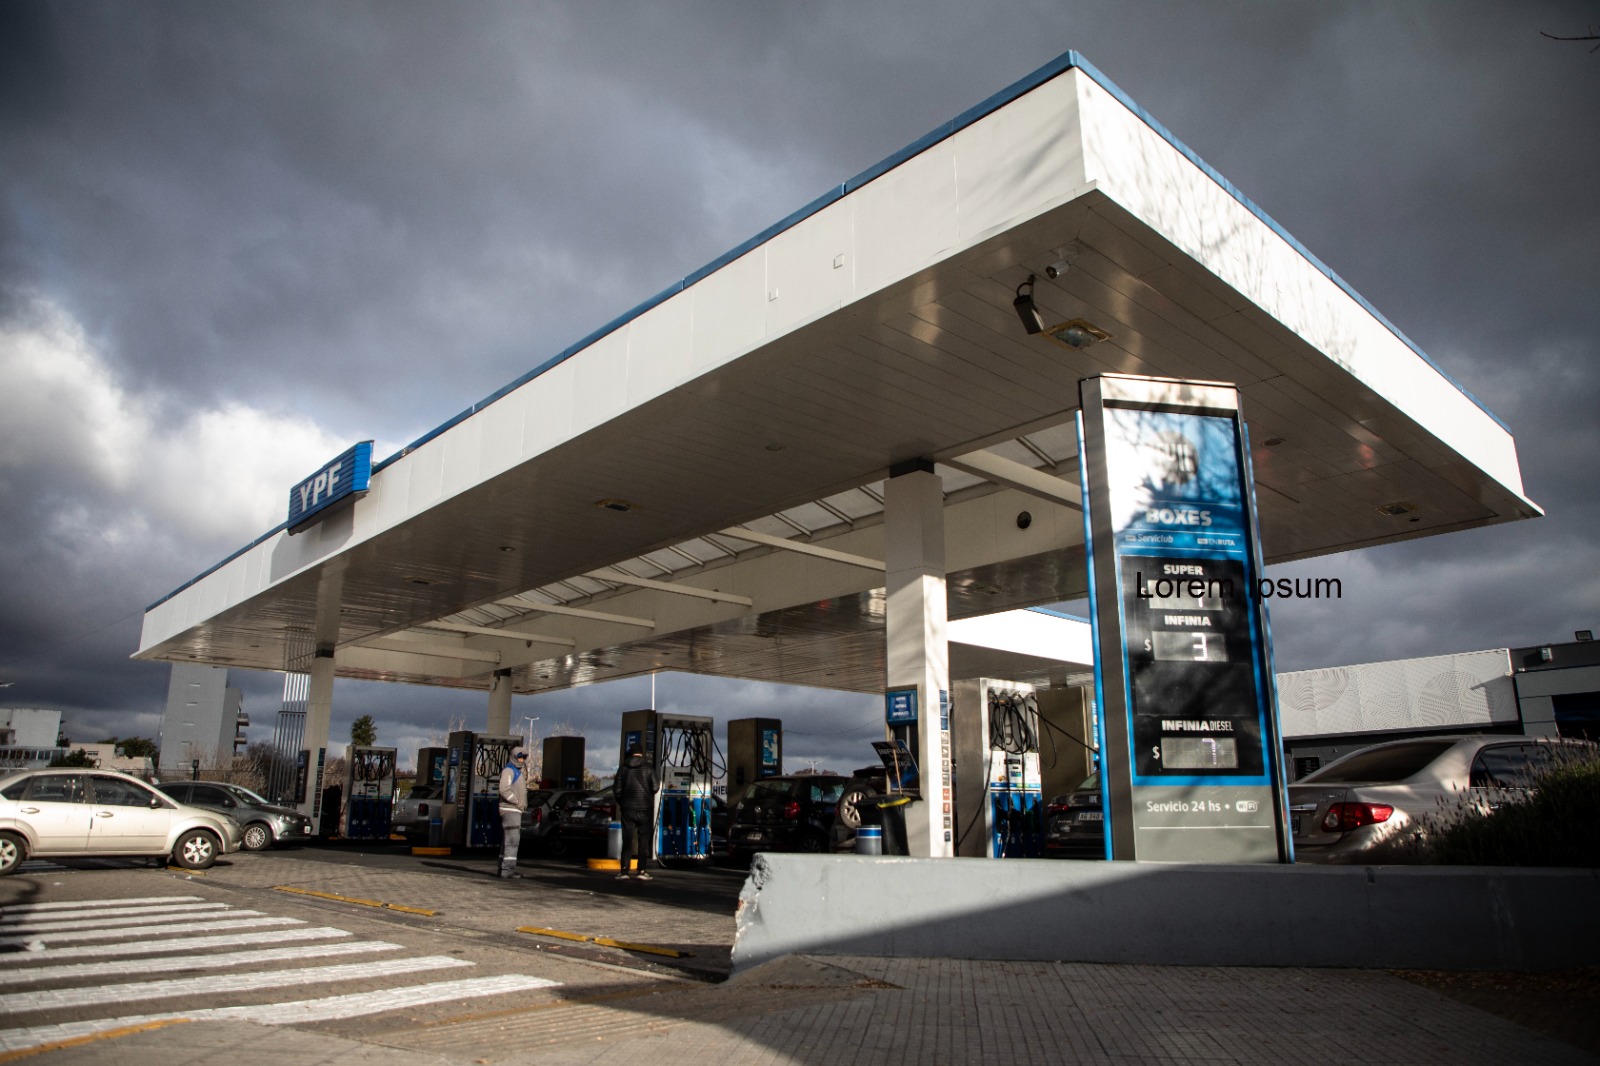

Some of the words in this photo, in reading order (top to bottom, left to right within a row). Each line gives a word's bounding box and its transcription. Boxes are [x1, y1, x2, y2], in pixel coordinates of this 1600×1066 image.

[300, 463, 342, 512] YPF
[1145, 508, 1213, 526] BOXES
[1137, 533, 1174, 543] Serviclub
[1163, 564, 1204, 576] SUPER
[1164, 615, 1212, 627] INFINIA
[1144, 638, 1152, 651] $
[1191, 632, 1209, 662] 3
[1152, 746, 1161, 760] $
[1146, 800, 1189, 812] Servicio
[1191, 801, 1206, 812] 24
[1208, 800, 1221, 812] hs
